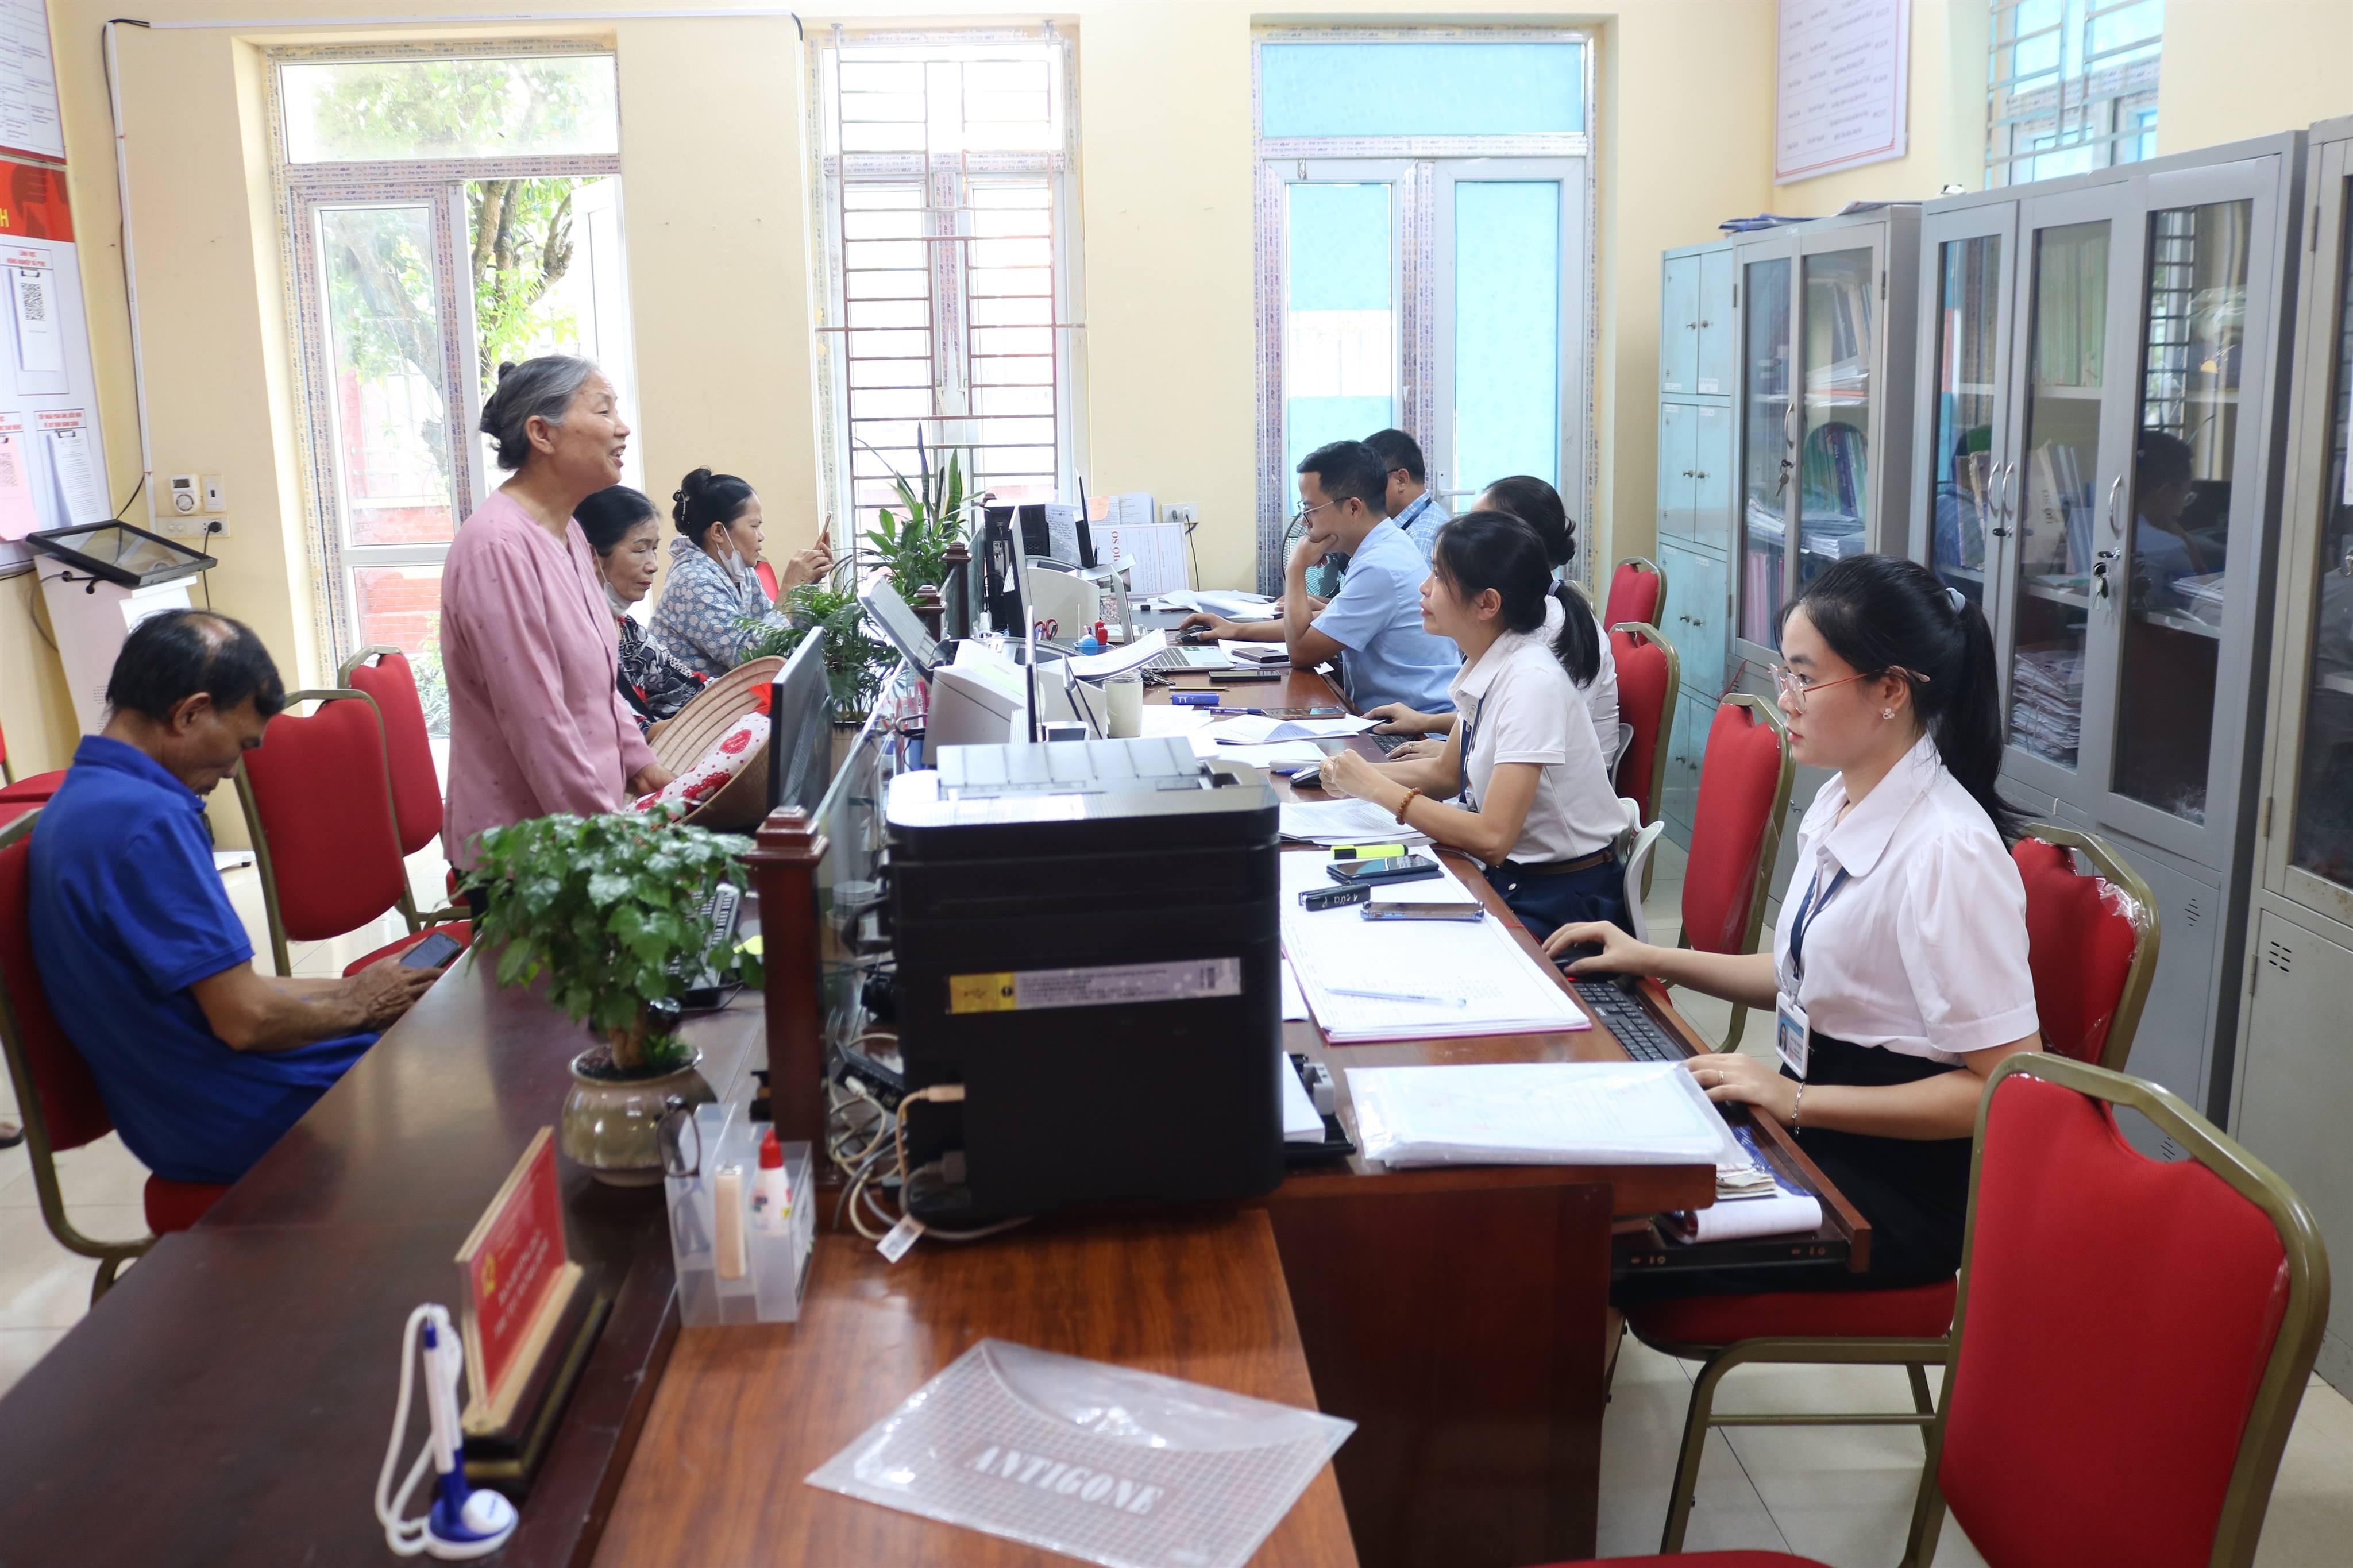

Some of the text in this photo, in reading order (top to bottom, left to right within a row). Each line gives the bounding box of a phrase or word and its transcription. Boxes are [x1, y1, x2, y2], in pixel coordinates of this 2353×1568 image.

[1109, 531, 1120, 562] HỒ SƠ
[965, 1445, 1165, 1515] ANTIGONE
